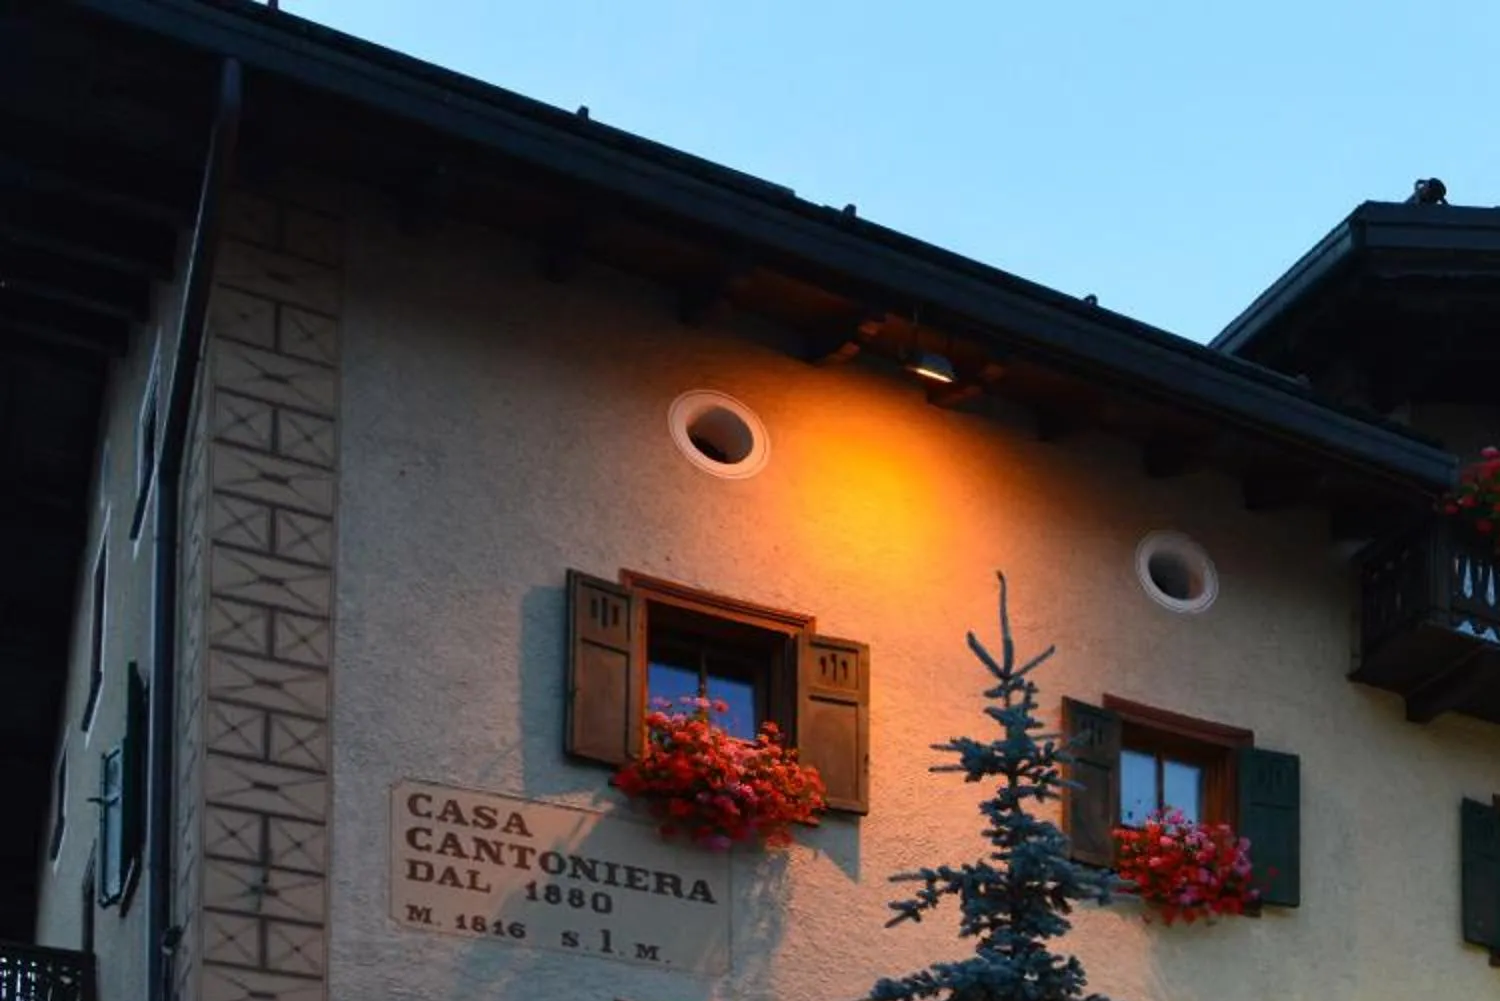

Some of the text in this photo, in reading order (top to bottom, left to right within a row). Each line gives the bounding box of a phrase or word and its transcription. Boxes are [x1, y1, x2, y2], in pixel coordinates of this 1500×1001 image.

[406, 792, 533, 838] CASA
[405, 826, 718, 905] CANTONIERA
[406, 858, 613, 915] DAL 1880
[406, 904, 443, 927] M.
[456, 914, 527, 940] 1816
